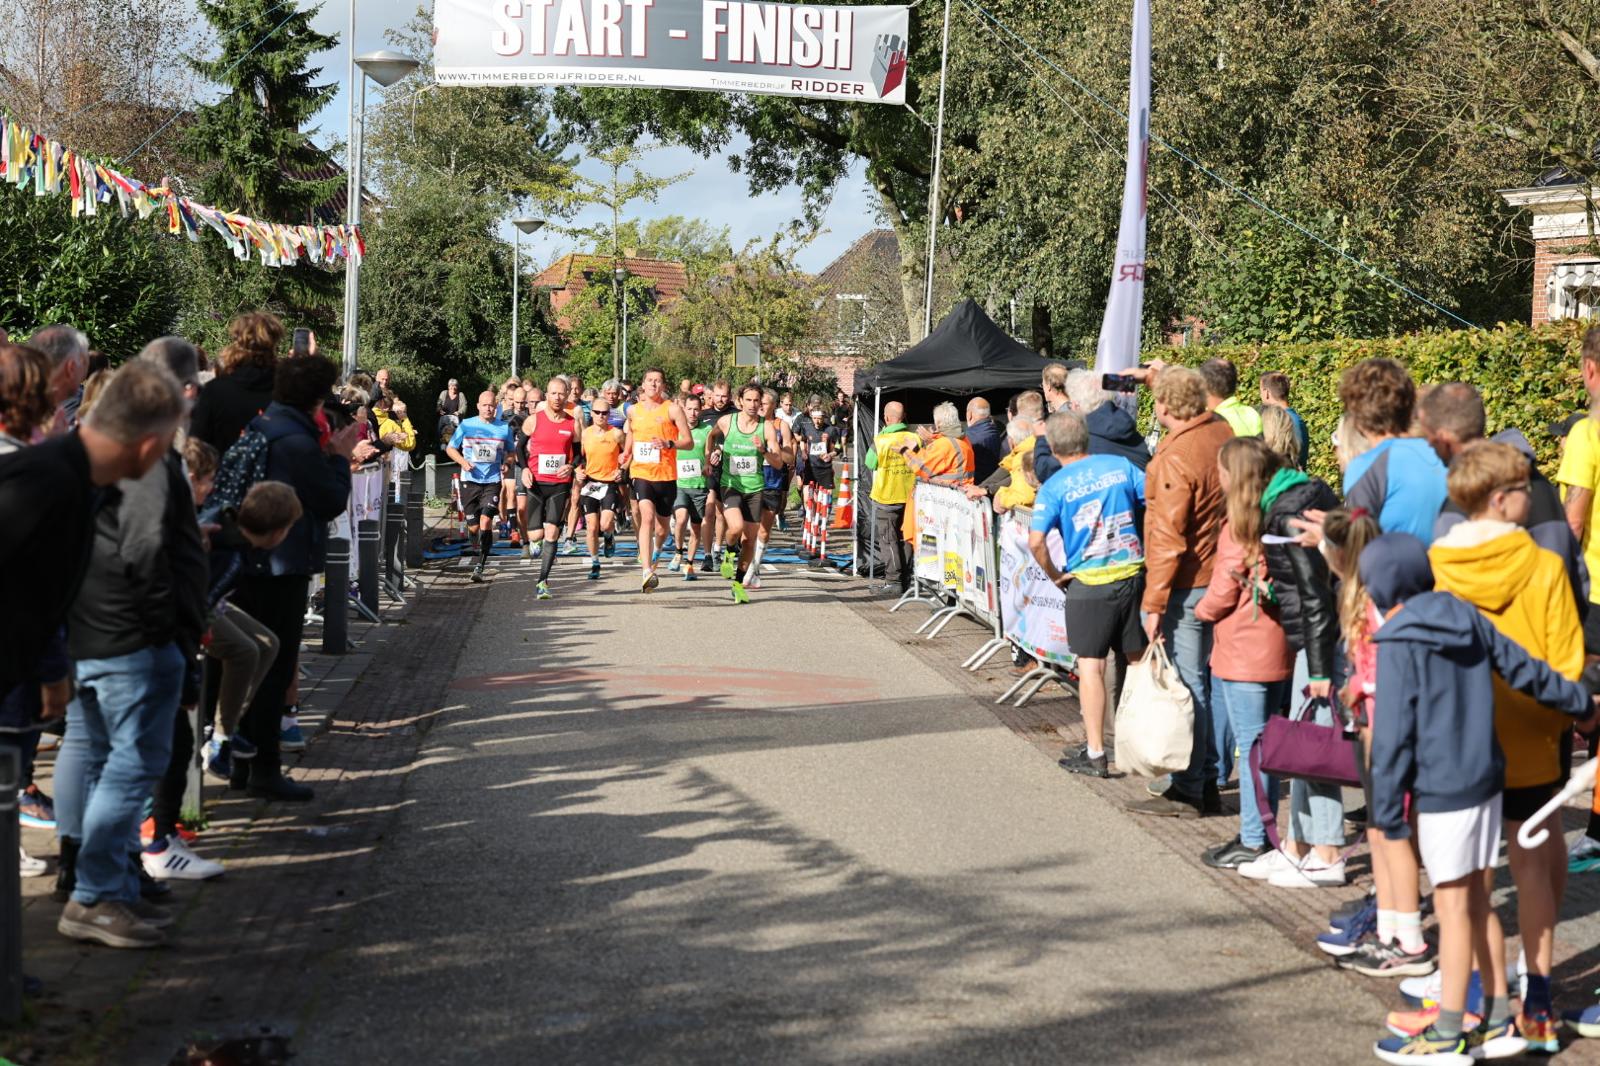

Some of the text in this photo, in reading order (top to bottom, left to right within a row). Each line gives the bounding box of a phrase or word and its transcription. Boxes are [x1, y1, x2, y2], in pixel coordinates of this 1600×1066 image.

[491, 0, 655, 57] START
[702, 1, 854, 70] FINISH
[438, 72, 645, 82] WWW.TIMMERBEDRIJFRIDDER.NL
[791, 79, 865, 95] RIDDER
[545, 460, 559, 468] 628
[682, 464, 695, 473] 634
[736, 461, 751, 470] 638
